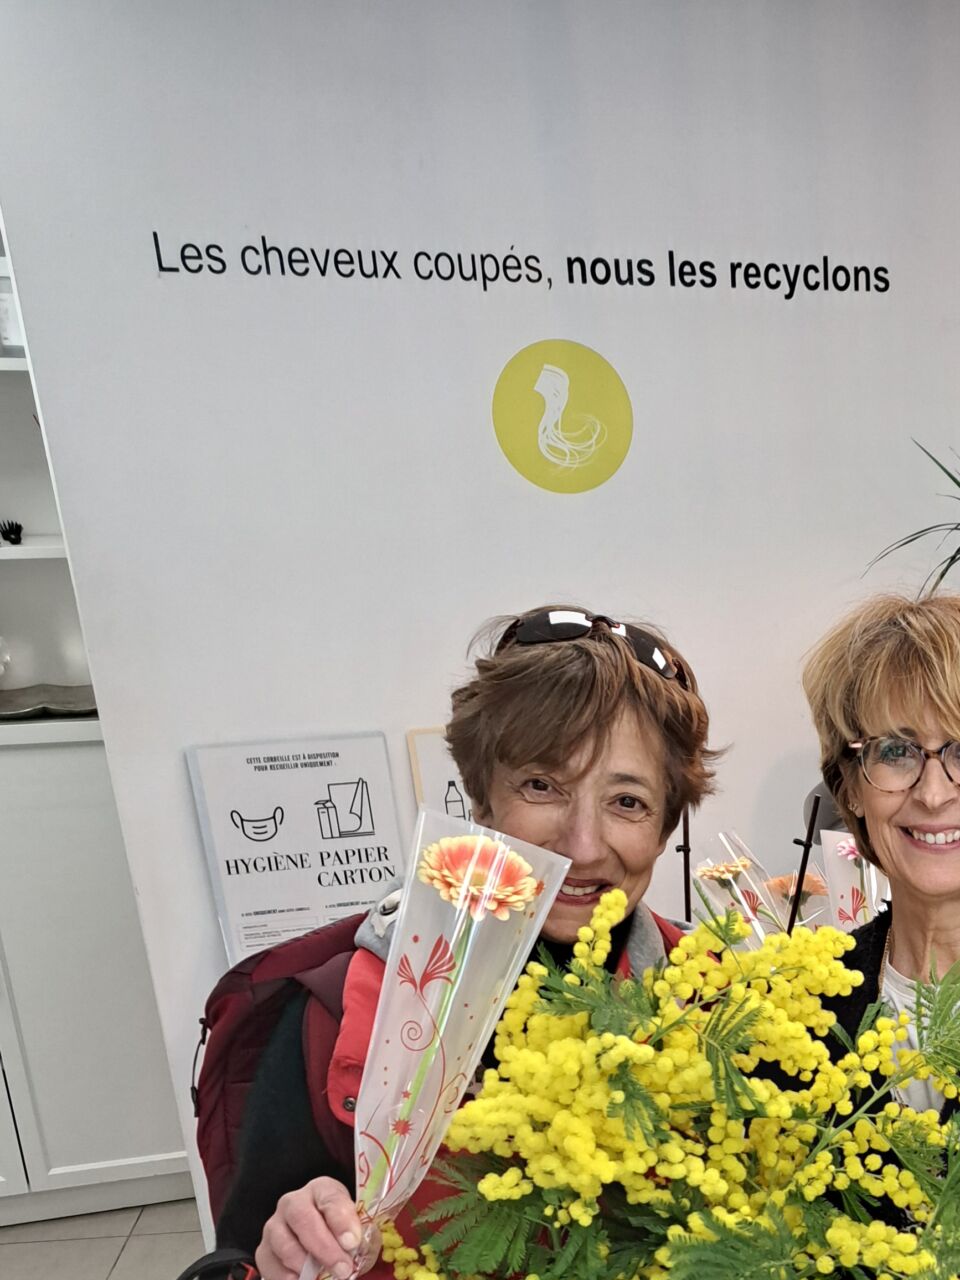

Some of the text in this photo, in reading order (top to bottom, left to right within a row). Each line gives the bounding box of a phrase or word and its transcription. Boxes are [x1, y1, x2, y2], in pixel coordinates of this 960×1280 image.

[152, 231, 890, 300] Les cheveux coupés, nous les recyclons
[308, 751, 339, 760] DISPOSITION
[224, 851, 312, 876] HYGIÈNE
[318, 845, 390, 868] PAPIER
[317, 865, 397, 888] CARTON
